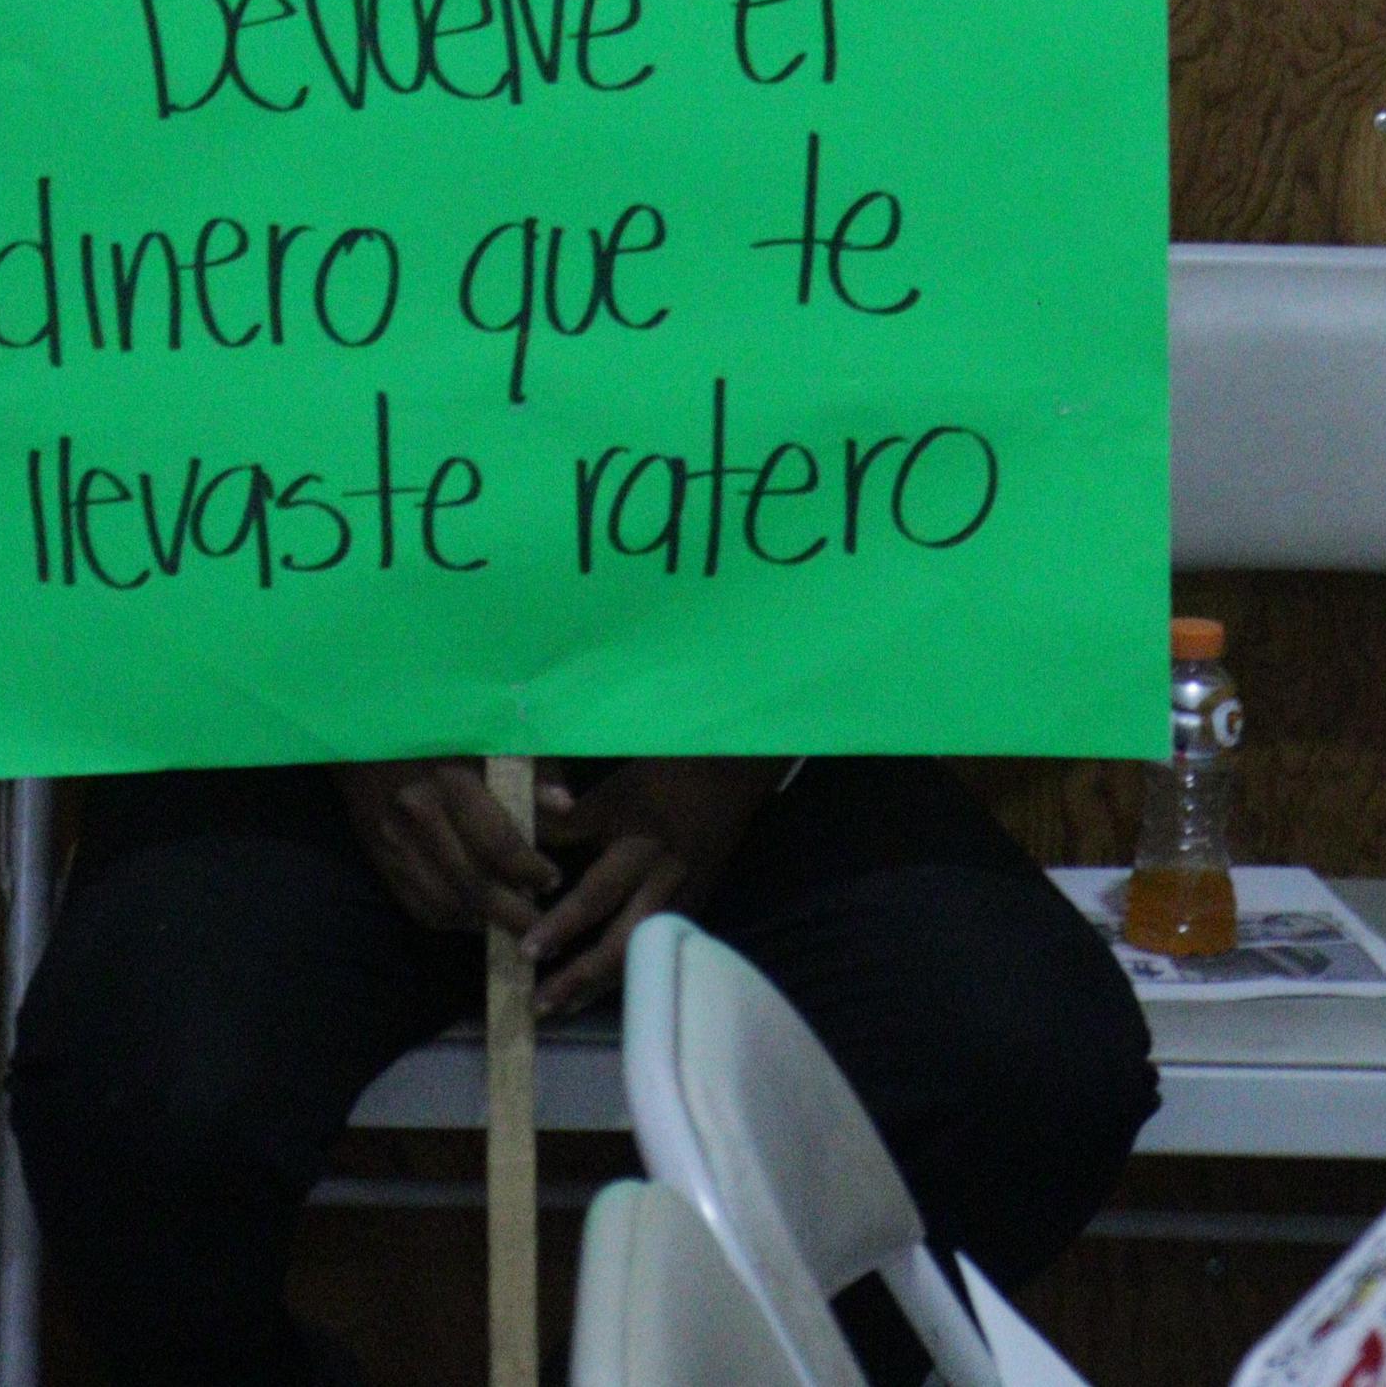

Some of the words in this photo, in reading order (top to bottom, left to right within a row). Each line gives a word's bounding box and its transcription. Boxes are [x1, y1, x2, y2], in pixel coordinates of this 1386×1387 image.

[459, 205, 669, 406] que
[754, 133, 921, 315] te
[27, 392, 489, 591] llevaste
[576, 378, 999, 578] ratero
